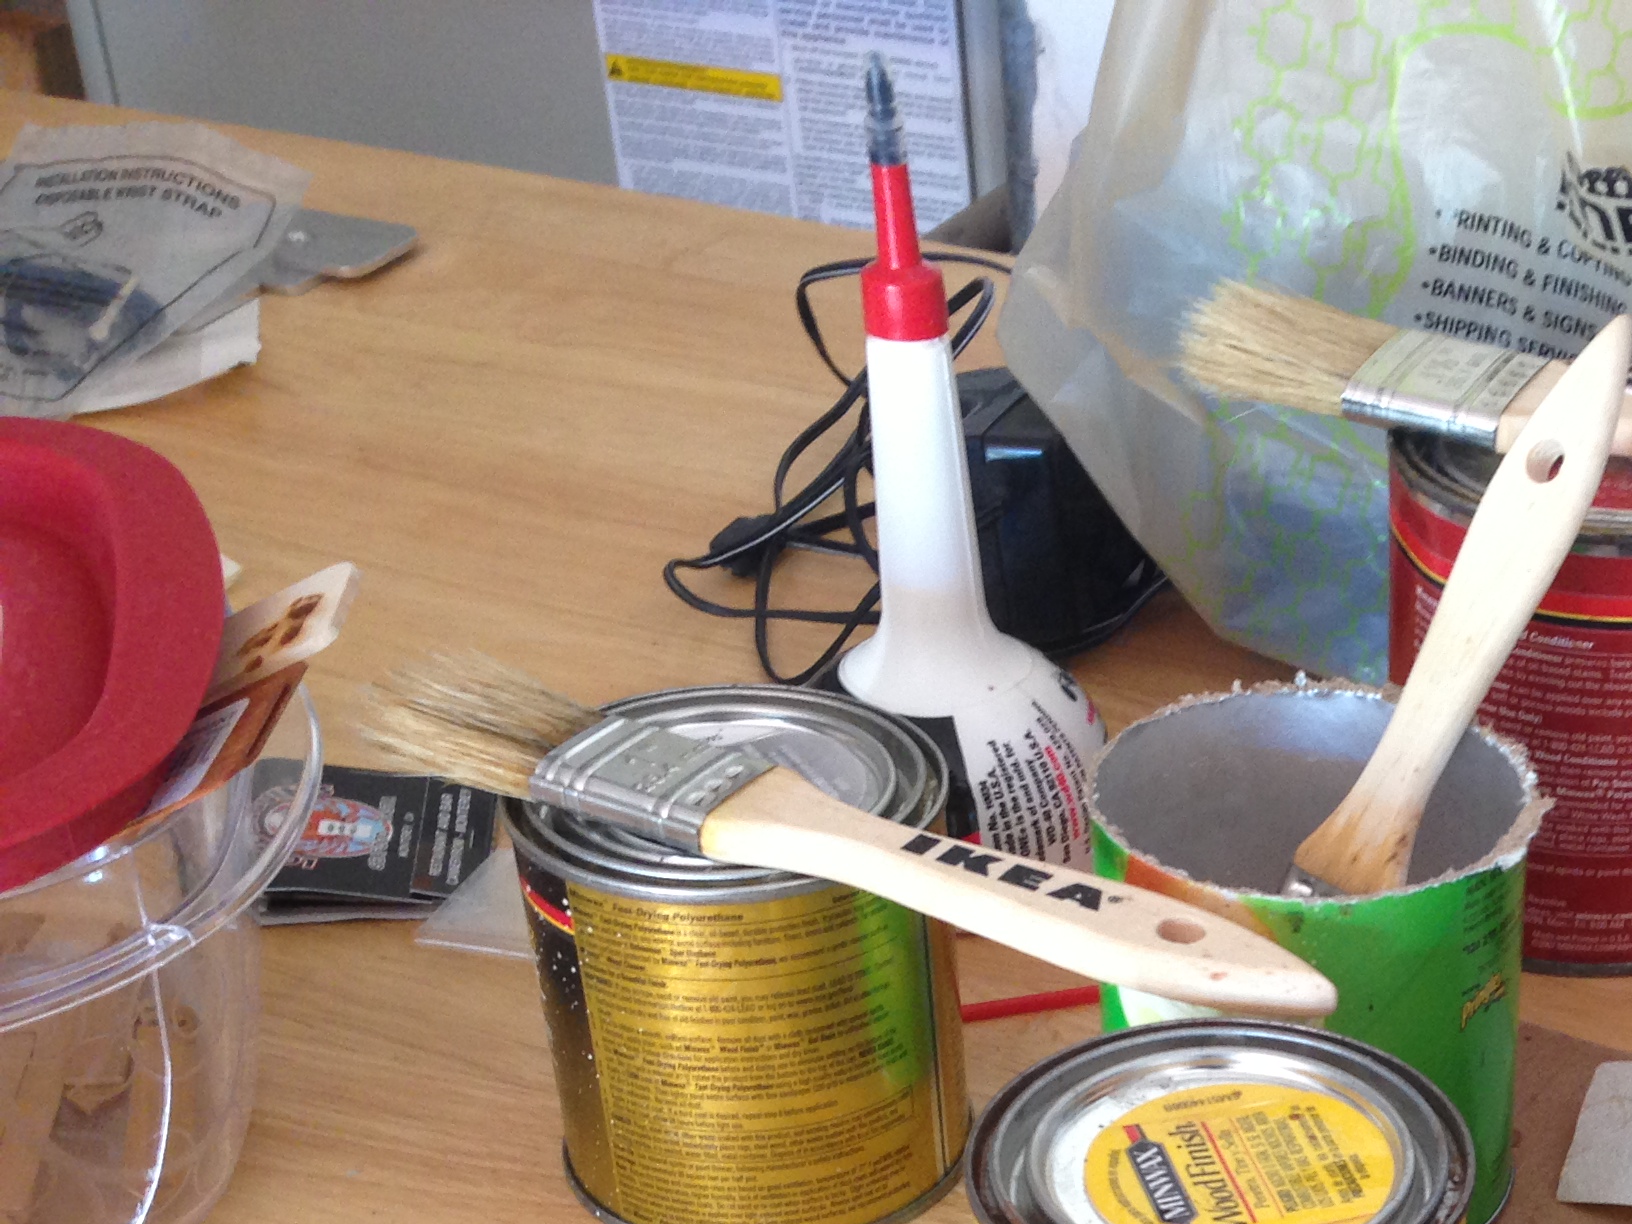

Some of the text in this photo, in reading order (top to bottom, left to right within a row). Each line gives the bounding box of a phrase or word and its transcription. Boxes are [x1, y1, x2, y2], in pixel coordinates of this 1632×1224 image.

[161, 187, 223, 218] STRAP
[1452, 207, 1534, 250] RINTING
[1536, 235, 1552, 257] &
[1437, 242, 1520, 280] BINDING
[1523, 268, 1537, 288] &
[1422, 310, 1512, 349] SHIPPING
[1430, 277, 1601, 342] BANNERS & SIGNS
[1529, 630, 1595, 651] Conditioner
[986, 740, 1016, 796] registered
[1563, 753, 1619, 767] Conditioner
[1019, 783, 1034, 804] and
[1024, 759, 1050, 809] Company
[1051, 791, 1063, 809] CA
[1010, 796, 1022, 815] the
[900, 833, 1104, 912] IKEA
[672, 912, 744, 924] Polyurethane
[1168, 1120, 1221, 1178] Finish
[1132, 1146, 1190, 1221] MINWAX
